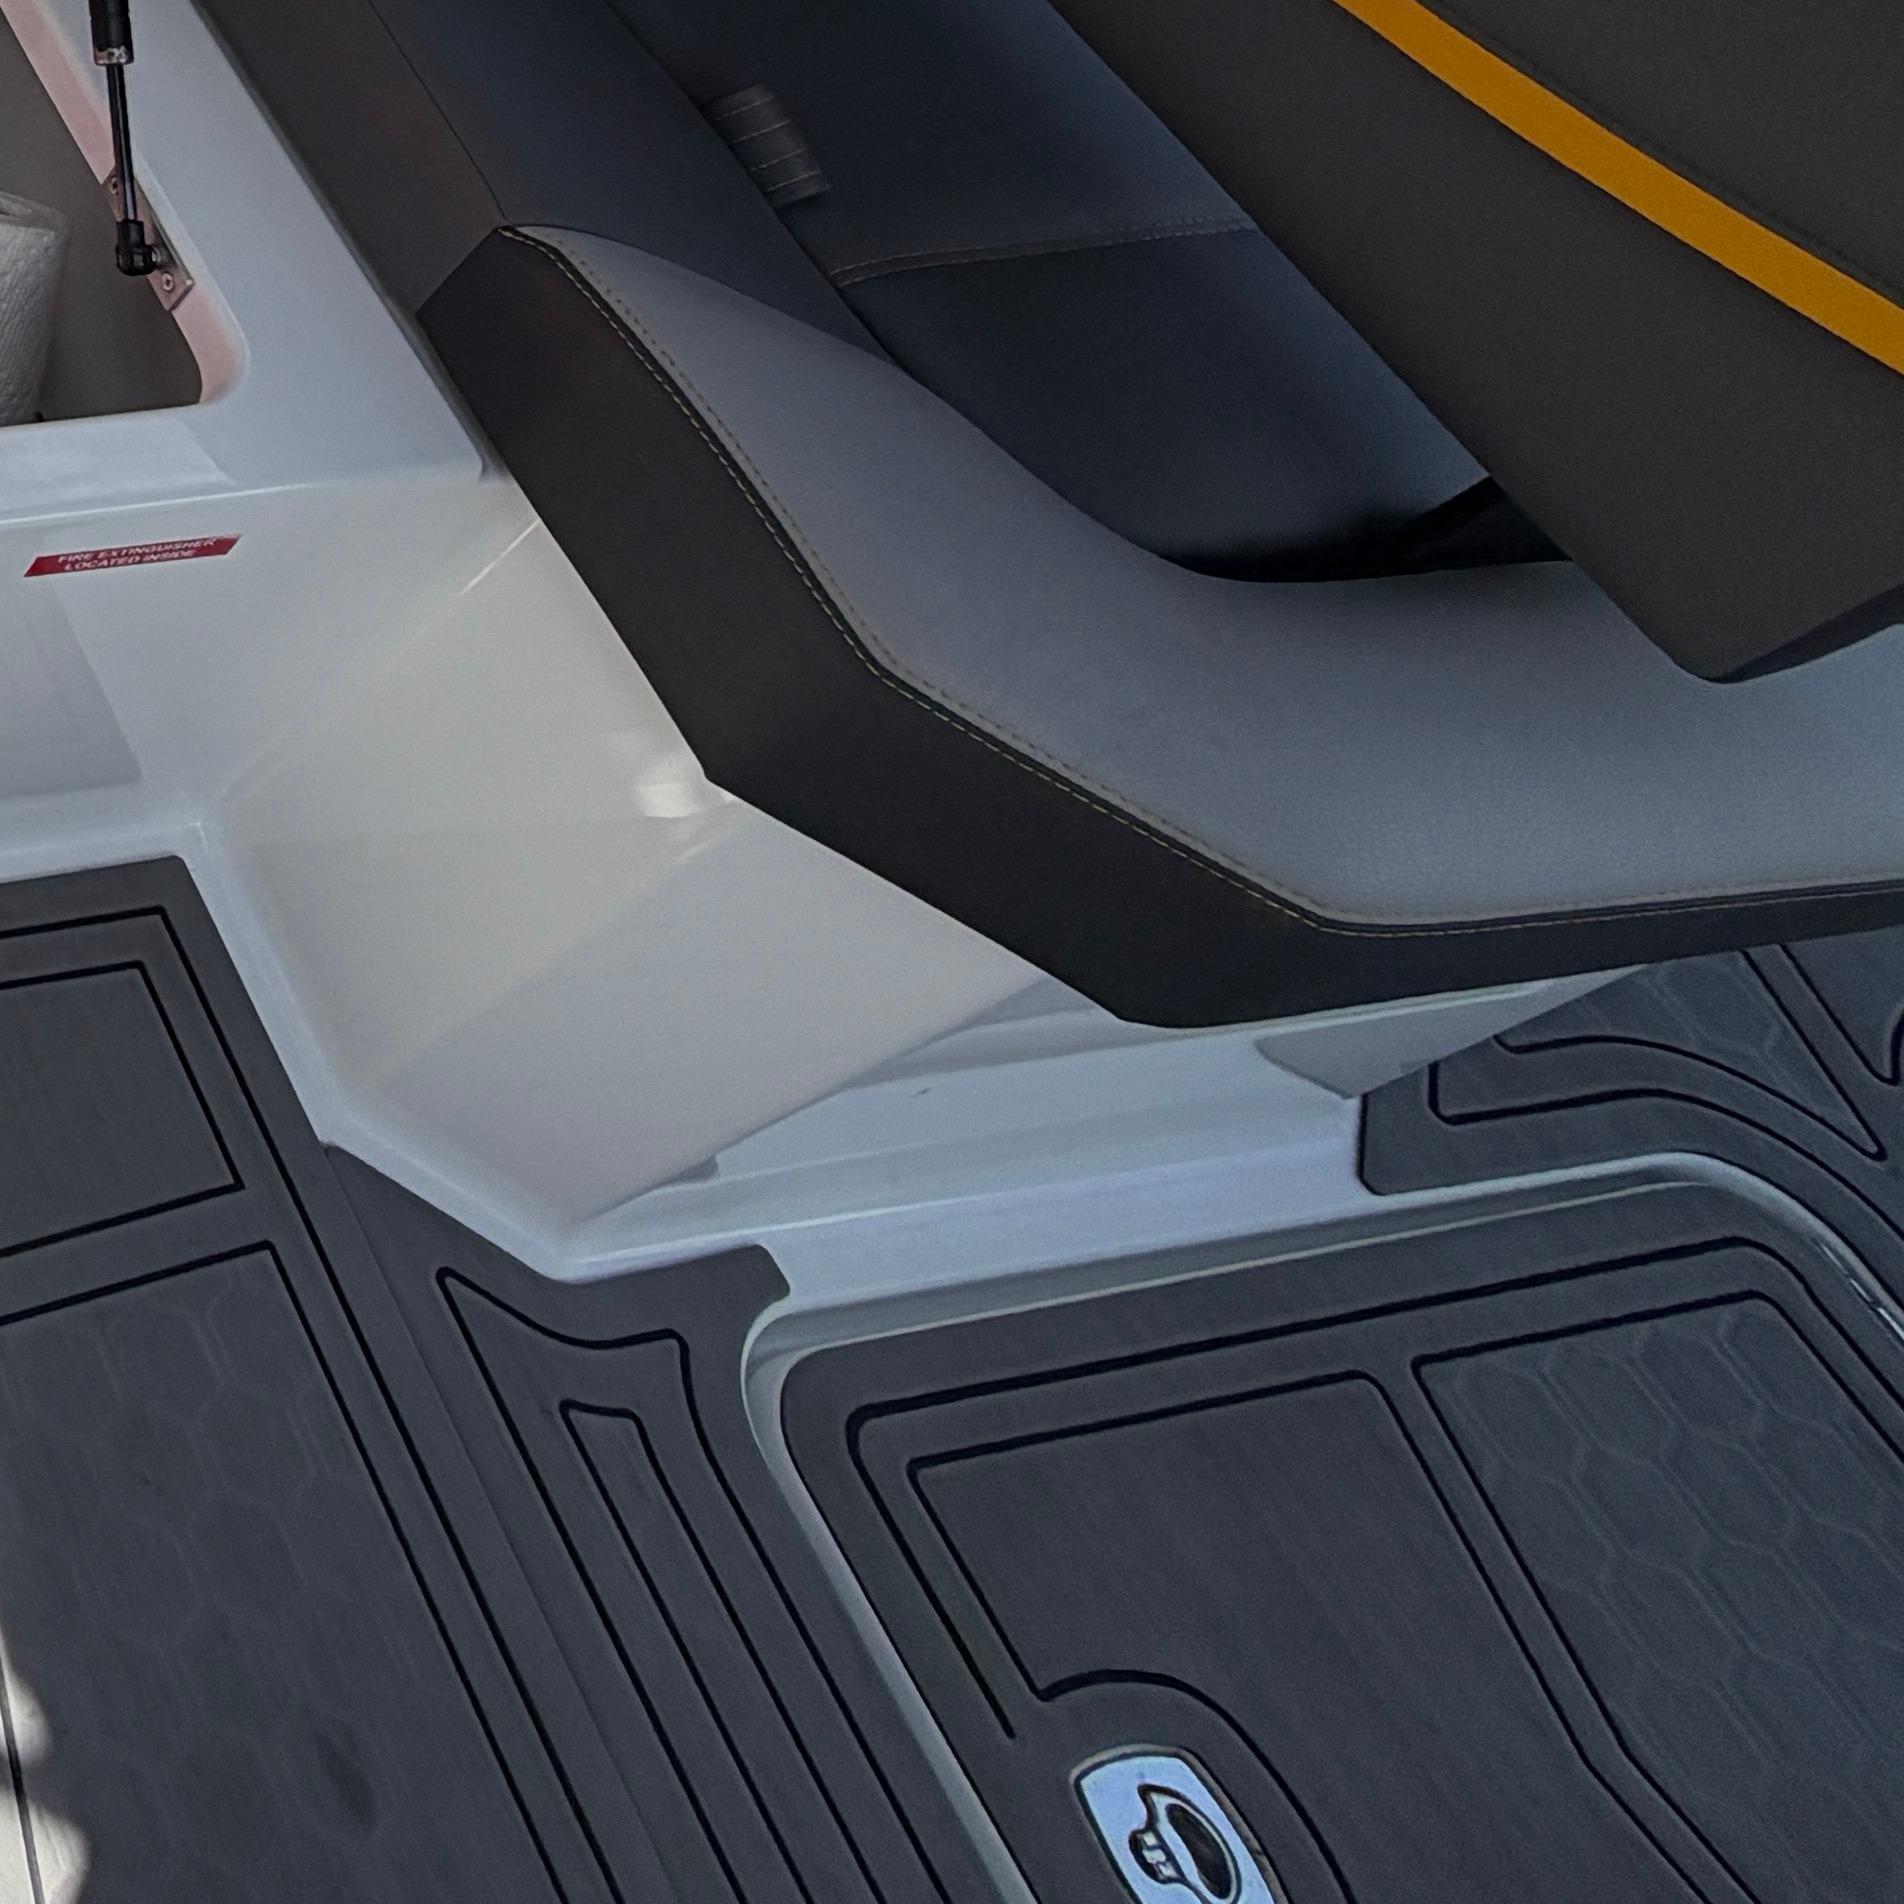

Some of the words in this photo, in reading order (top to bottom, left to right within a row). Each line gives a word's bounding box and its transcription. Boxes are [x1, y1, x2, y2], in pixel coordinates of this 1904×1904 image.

[57, 552, 92, 564] FIRE
[97, 538, 217, 559] EXTINGUISHER
[64, 555, 141, 572] LOCATED
[144, 549, 197, 563] INSIDE
